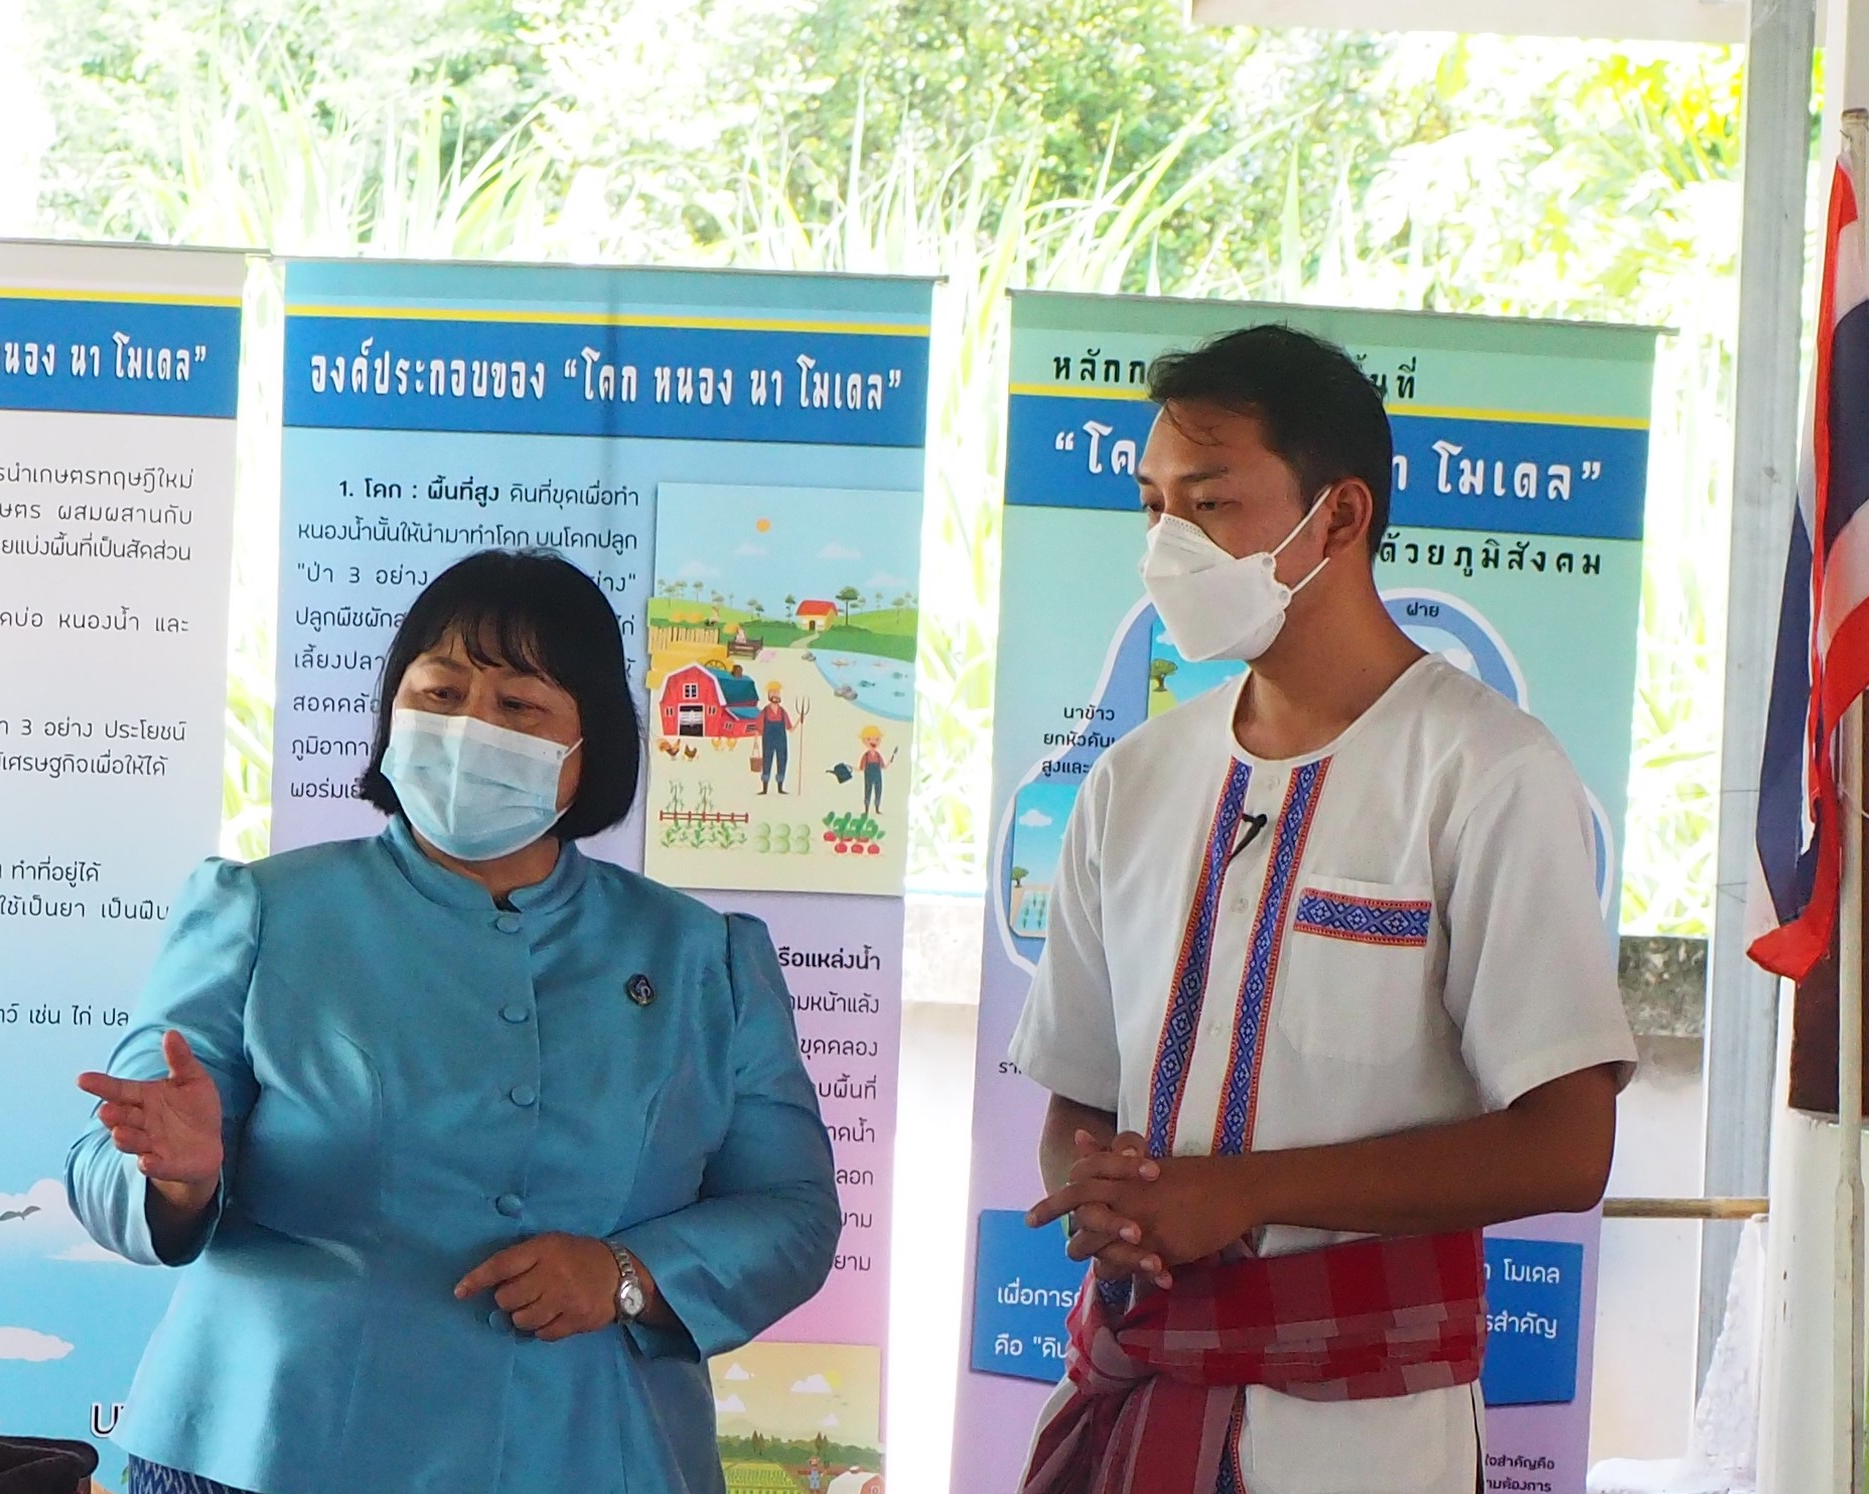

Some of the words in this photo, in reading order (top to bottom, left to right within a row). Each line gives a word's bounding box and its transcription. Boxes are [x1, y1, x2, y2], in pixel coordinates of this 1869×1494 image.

[70, 343, 101, 378] นา
[310, 336, 547, 401] องค์ประกอบของ
[655, 366, 733, 406] หนอง
[749, 369, 783, 407] นา
[1053, 349, 1145, 385] หลักก
[1432, 440, 1602, 501] โมเดล”
[338, 480, 354, 498] 1.
[365, 477, 402, 500] โคก
[427, 476, 500, 508] พื้นที่สูง
[510, 480, 639, 511] ดินที่ขุดเพื่อทำ
[57, 503, 193, 526] ผสมผสานกับ
[297, 515, 530, 548] หนองน้ำนั้นให้นำมาทำโคก
[535, 526, 638, 556] บนโคกปลูก
[1378, 532, 1601, 578] ด้วยภูมิสังคม
[348, 567, 361, 584] 3
[58, 605, 140, 632] หนองน้ำ
[155, 616, 190, 634] และ
[295, 606, 406, 633] ปลูกพืชผักส
[1405, 602, 1440, 618] ฝาย
[1063, 704, 1116, 722] นาข้าว
[21, 718, 33, 736] 3
[43, 716, 93, 739] อย่าง
[104, 720, 188, 743] ประโยชน์
[1043, 730, 1116, 749] ยกหัวคัน
[11, 855, 102, 888] ทำที่อยู่ได้
[778, 944, 881, 971] รือแหล่งน้ำ
[29, 1003, 61, 1025] เช่น
[72, 1004, 92, 1027] ไก่
[103, 1007, 130, 1028] ปล
[818, 1072, 877, 1101] บพื้นที่
[1503, 1258, 1561, 1285] โมเดล
[994, 1333, 1023, 1357] คือ
[1485, 1309, 1558, 1340] รสำคัญ
